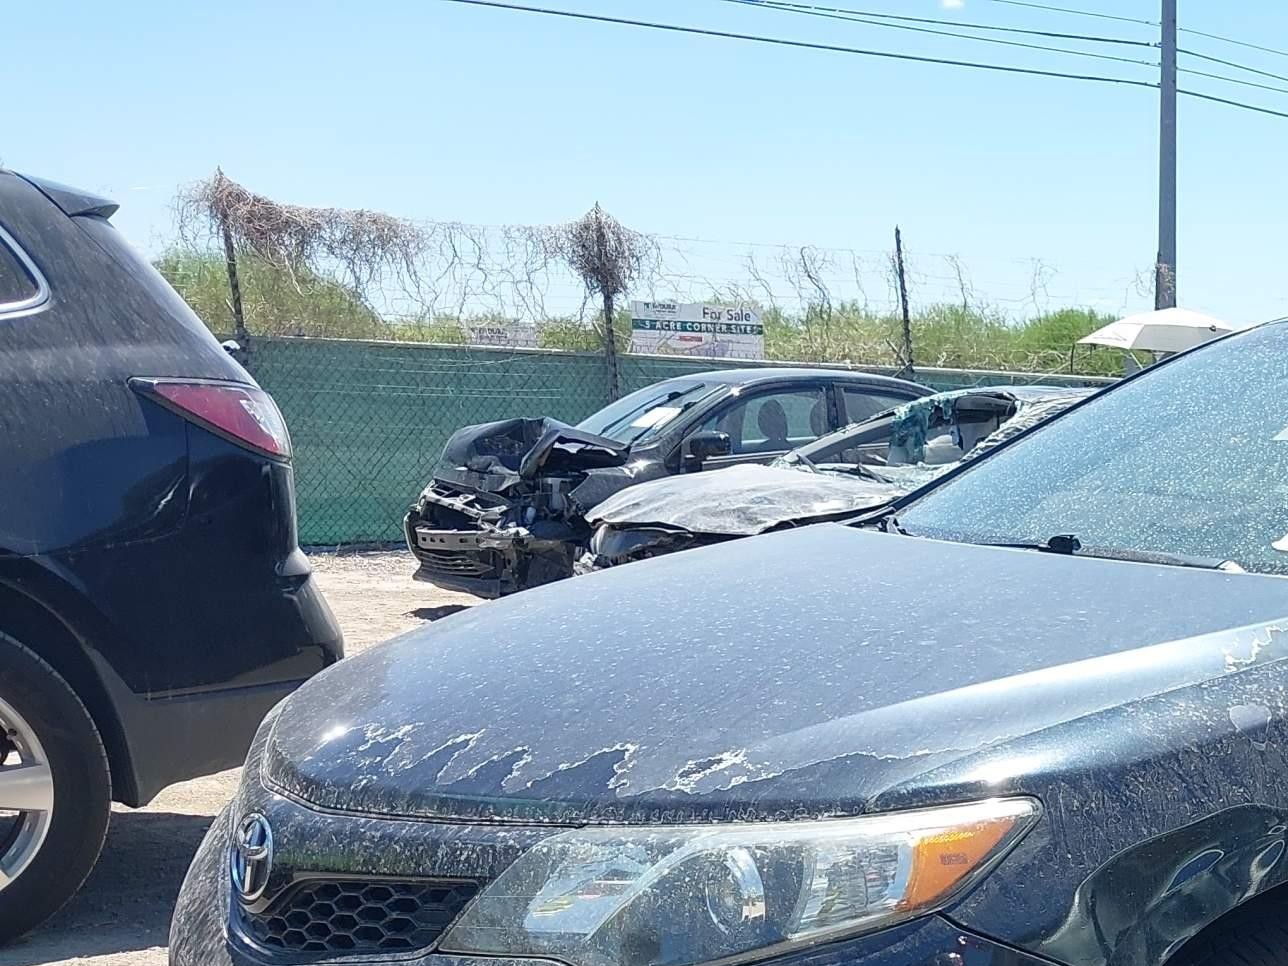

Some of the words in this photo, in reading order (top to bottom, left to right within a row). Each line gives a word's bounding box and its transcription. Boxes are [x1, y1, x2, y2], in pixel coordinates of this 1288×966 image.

[702, 307, 722, 322] For
[727, 309, 751, 322] Sale
[655, 320, 682, 331] ACRE
[686, 322, 728, 333] CORNER
